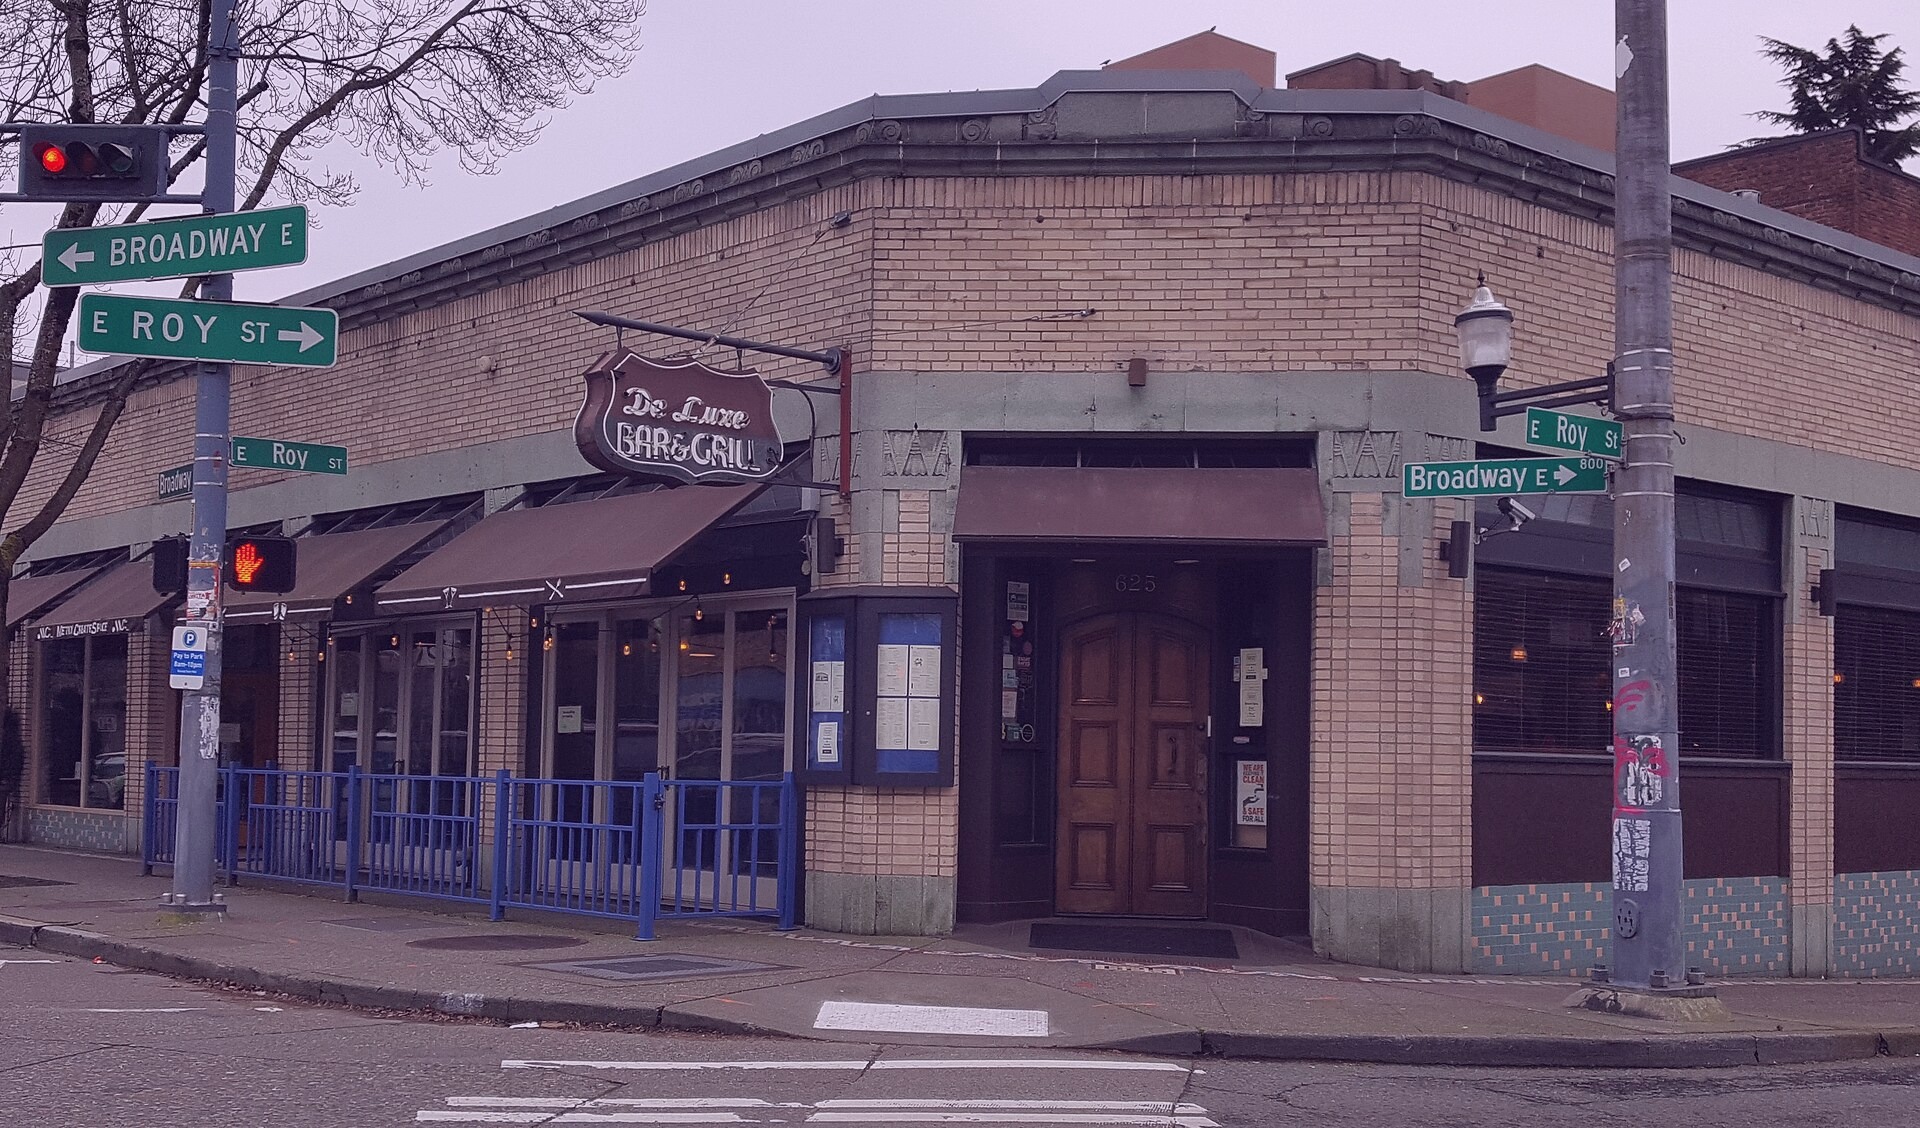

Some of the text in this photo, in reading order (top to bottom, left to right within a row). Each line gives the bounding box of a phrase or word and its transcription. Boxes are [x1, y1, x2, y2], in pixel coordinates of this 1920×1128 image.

[110, 223, 293, 267] BROADWAY E
[93, 311, 270, 344] E ROY ST
[622, 386, 751, 430] De Luxe
[1531, 415, 1618, 451] E Roy St
[237, 443, 343, 470] E Roy ST
[1580, 457, 1604, 470] 800
[159, 469, 192, 496] Broadway
[1411, 464, 1548, 492] Broadway E
[1115, 574, 1157, 593] 625
[173, 652, 183, 660] Pay
[1243, 764, 1264, 772] WE ARE
[1243, 775, 1264, 784] CLEAN
[1242, 815, 1264, 823] FOR ALL
[1248, 807, 1264, 815] SAFE
